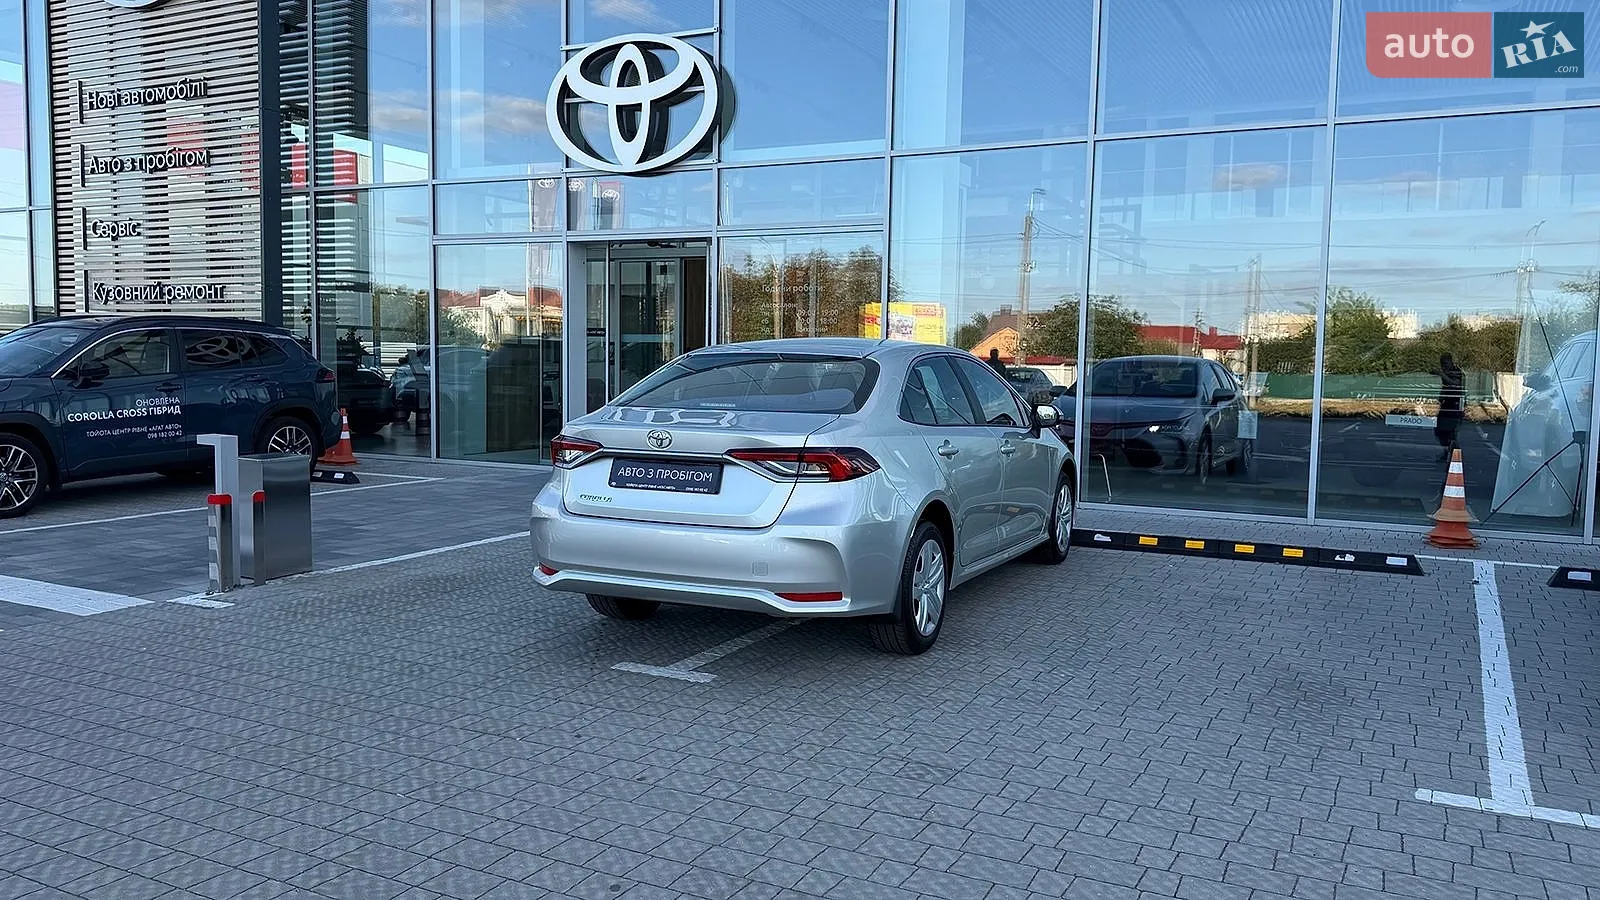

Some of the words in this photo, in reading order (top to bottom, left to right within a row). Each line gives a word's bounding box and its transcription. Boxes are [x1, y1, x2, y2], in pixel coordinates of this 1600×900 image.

[86, 89, 119, 110] Нові
[121, 77, 206, 106] автомобілі
[88, 155, 121, 174] Авто
[125, 156, 133, 170] з
[137, 147, 208, 173] пробігом
[91, 218, 138, 239] Сервіс
[93, 281, 161, 305] Кузовний
[165, 284, 223, 304] ремонт
[135, 396, 181, 407] ОНОВЛЕНА
[67, 410, 115, 422] COROLLA
[116, 407, 147, 418] CROSS
[149, 405, 182, 415] ГІБРИД
[1400, 416, 1422, 424] PRADO
[86, 429, 111, 437] ТОЙОТА
[112, 427, 131, 435] ЦЕНТР
[618, 466, 645, 478] АВТО
[646, 468, 654, 479] З
[655, 468, 713, 482] ПРОБІГОМ
